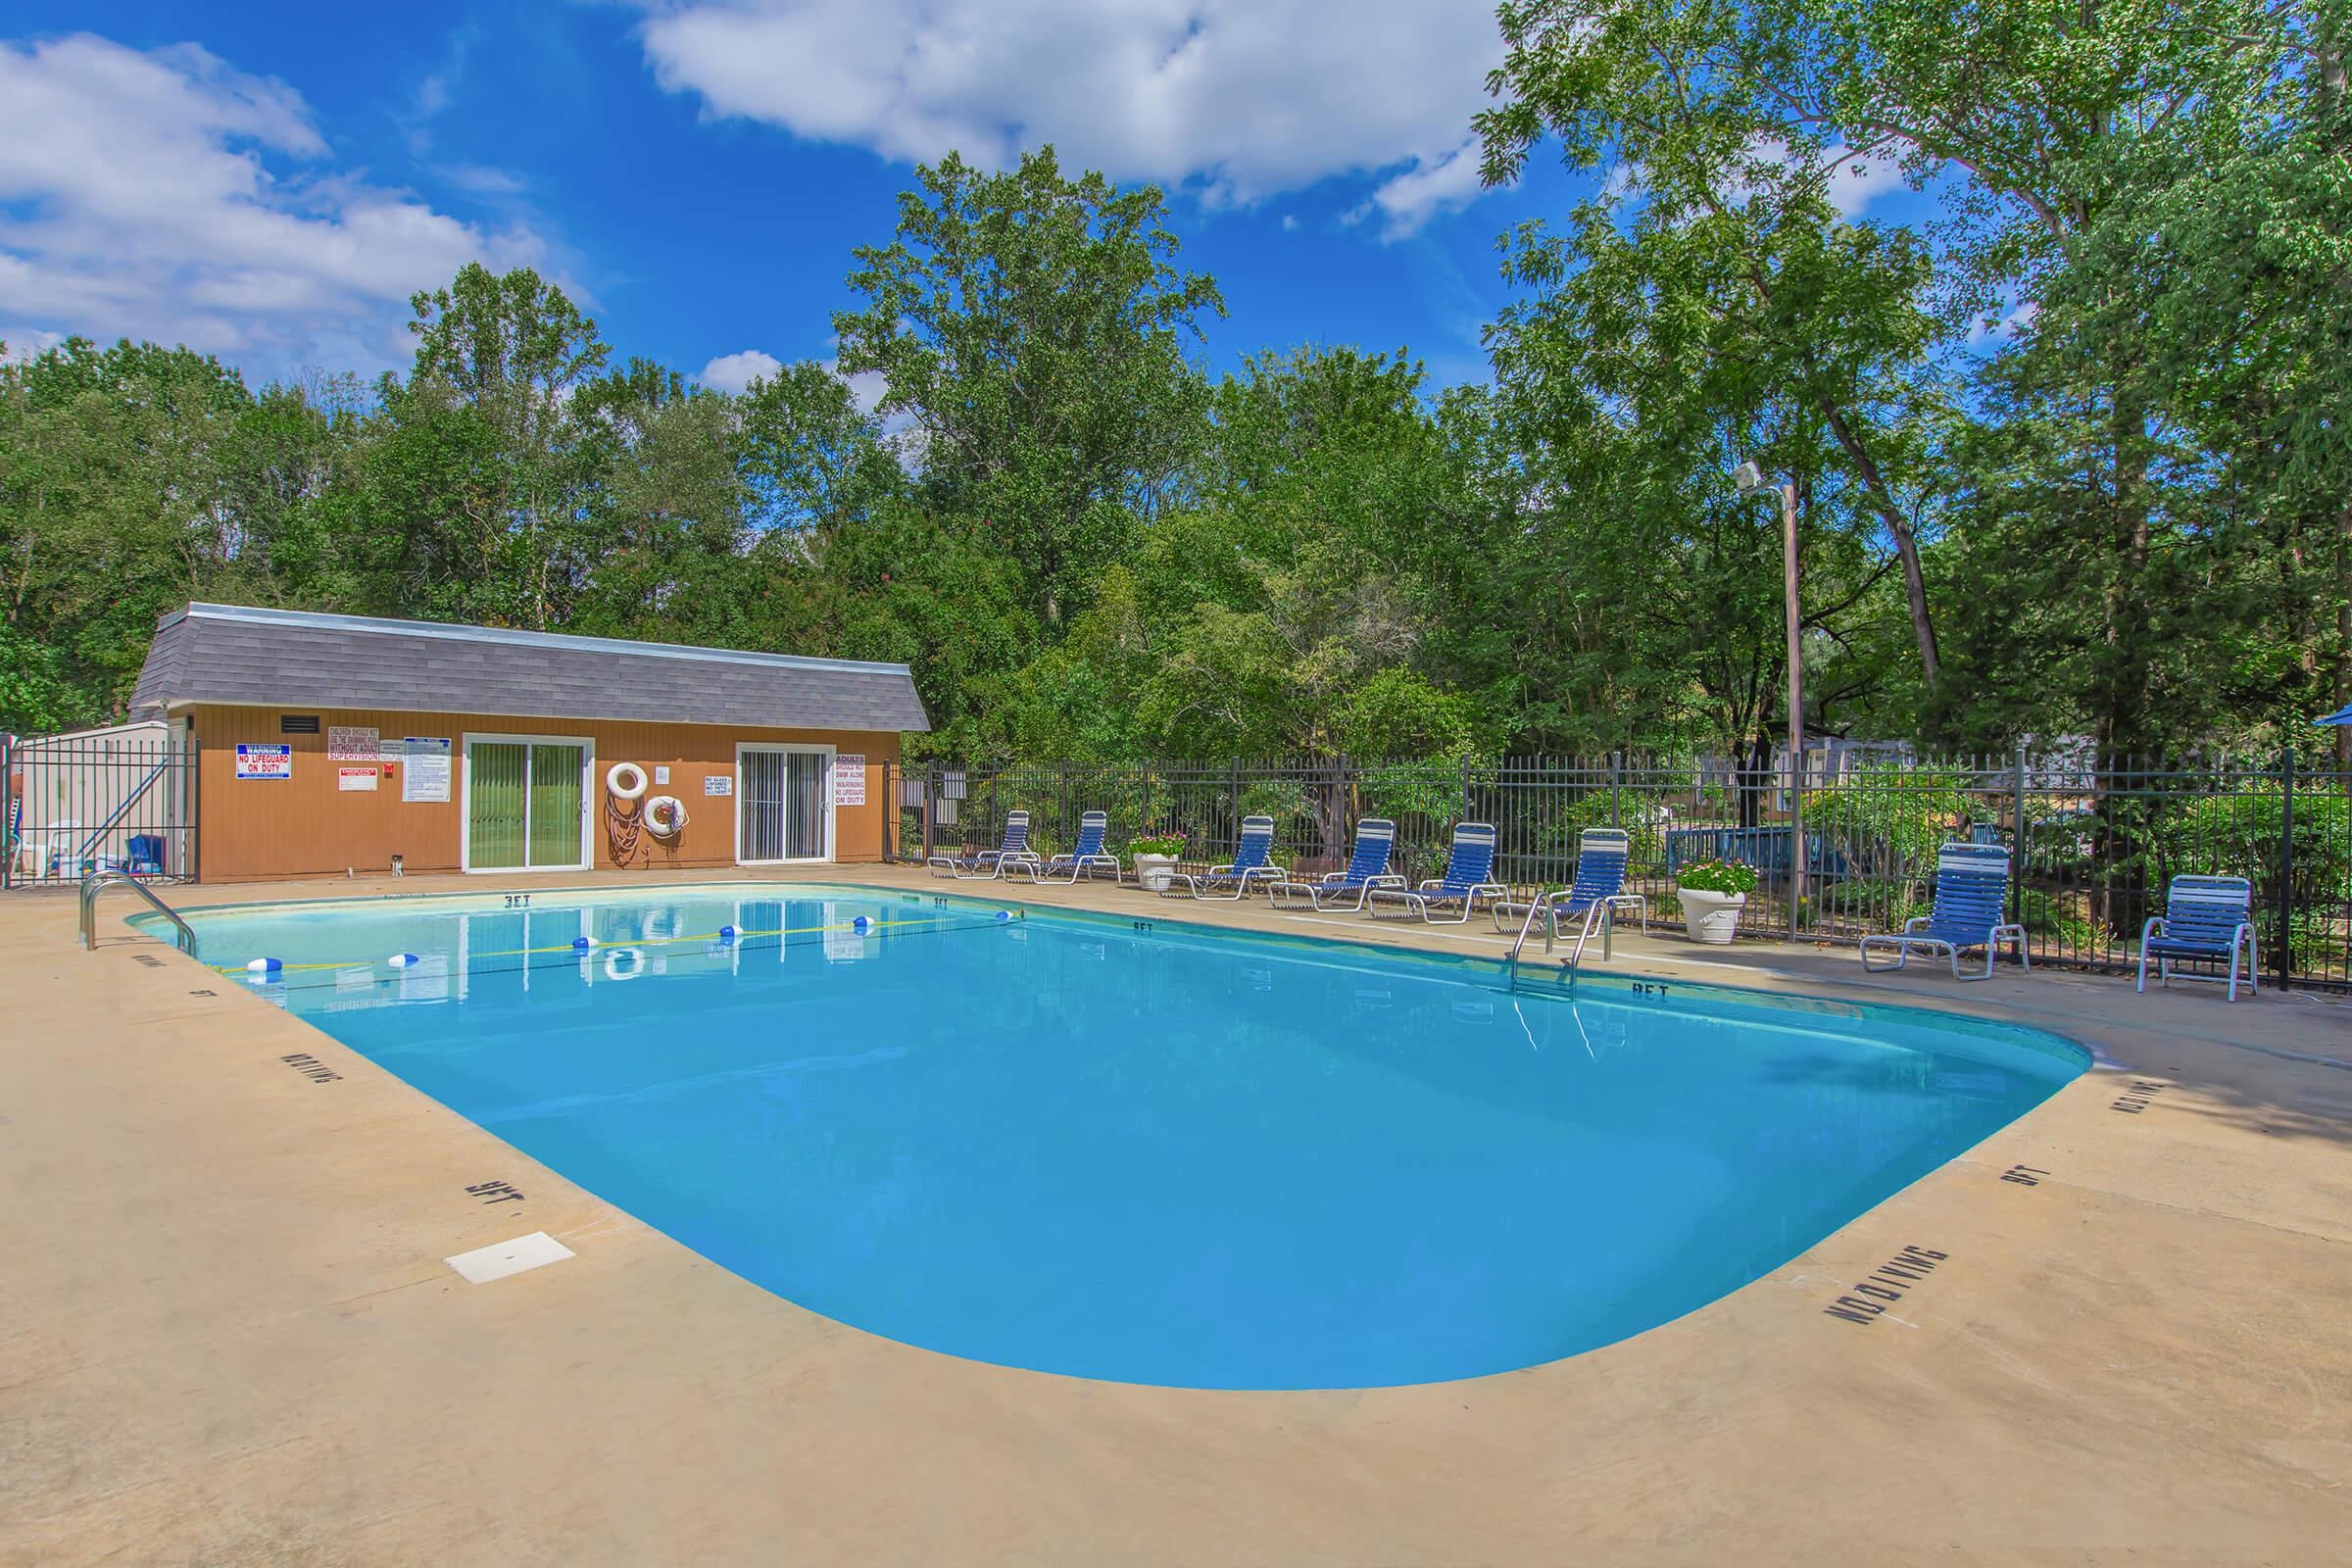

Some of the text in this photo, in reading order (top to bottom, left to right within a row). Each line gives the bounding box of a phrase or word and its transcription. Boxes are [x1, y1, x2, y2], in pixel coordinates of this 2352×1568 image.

[246, 745, 282, 754] WARNING
[330, 744, 359, 753] WITHOUT
[239, 755, 289, 763] NO LIFEGUARD
